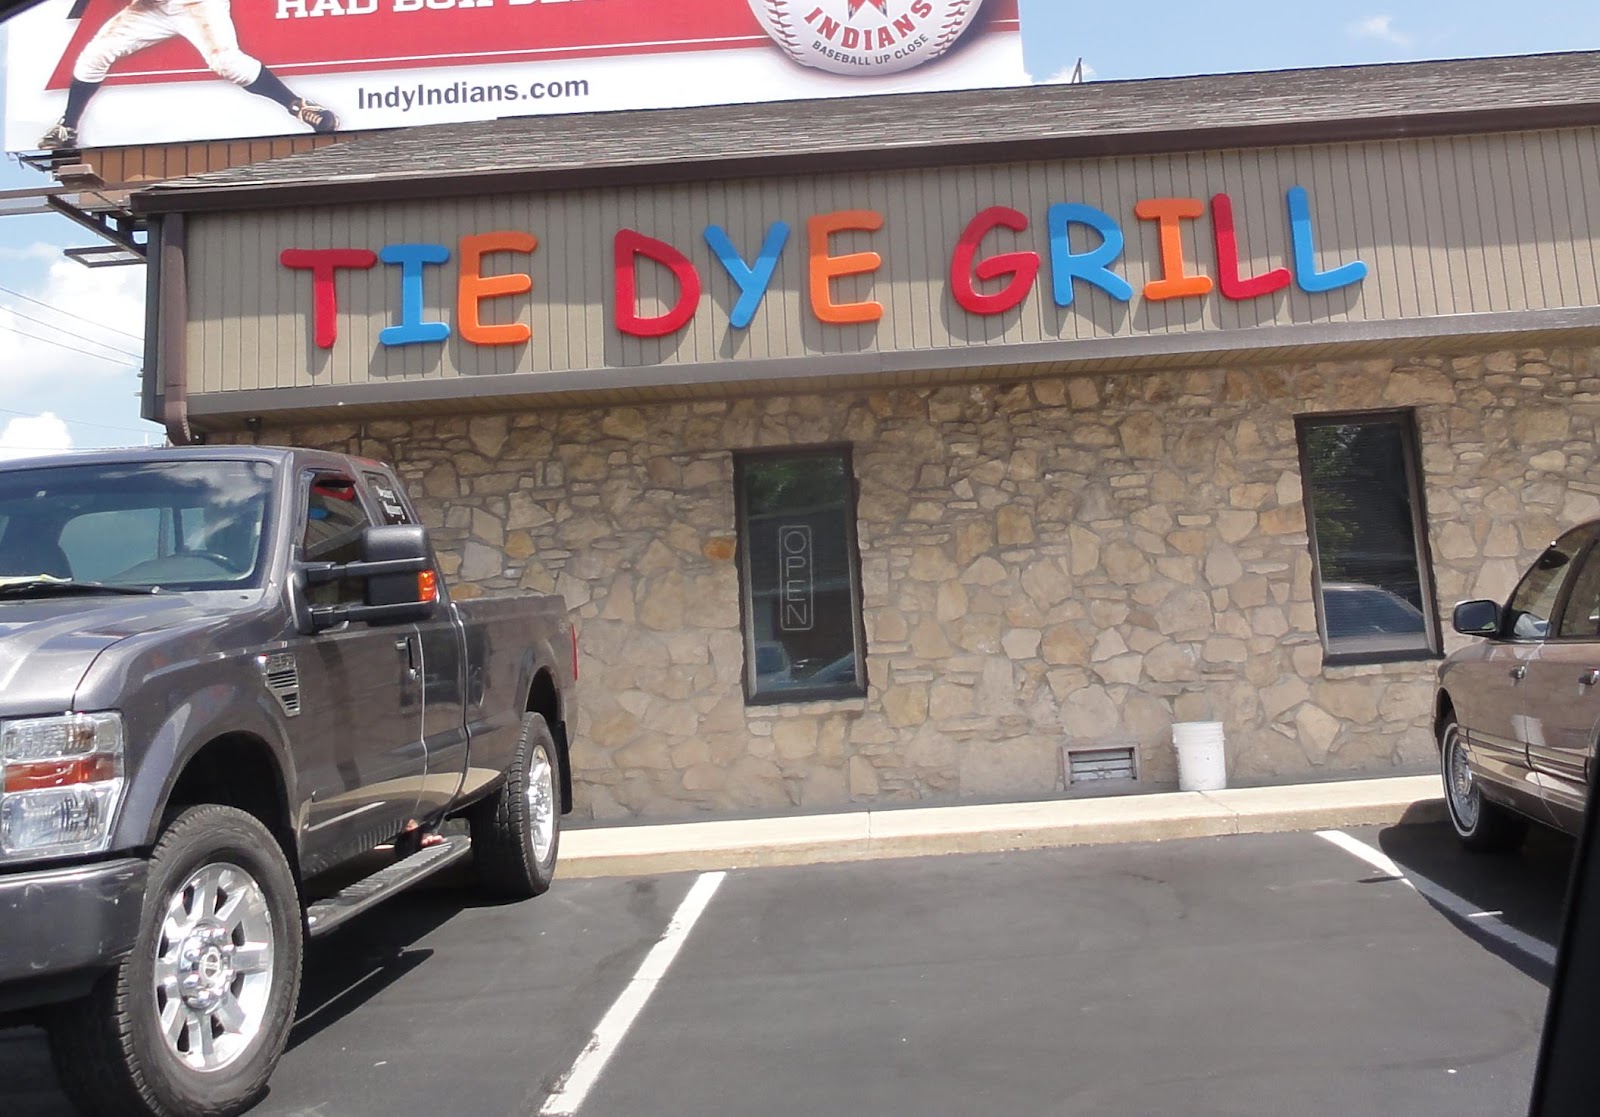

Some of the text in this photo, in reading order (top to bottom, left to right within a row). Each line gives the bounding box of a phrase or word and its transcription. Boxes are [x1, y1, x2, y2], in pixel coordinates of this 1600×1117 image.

[804, 0, 932, 50] INDIANS
[812, 33, 928, 66] BASEBALL UP CLOSE
[358, 78, 589, 112] IndyIndians.com
[280, 185, 1368, 349] TIE DYE GRILL
[784, 531, 807, 625] OPEN
